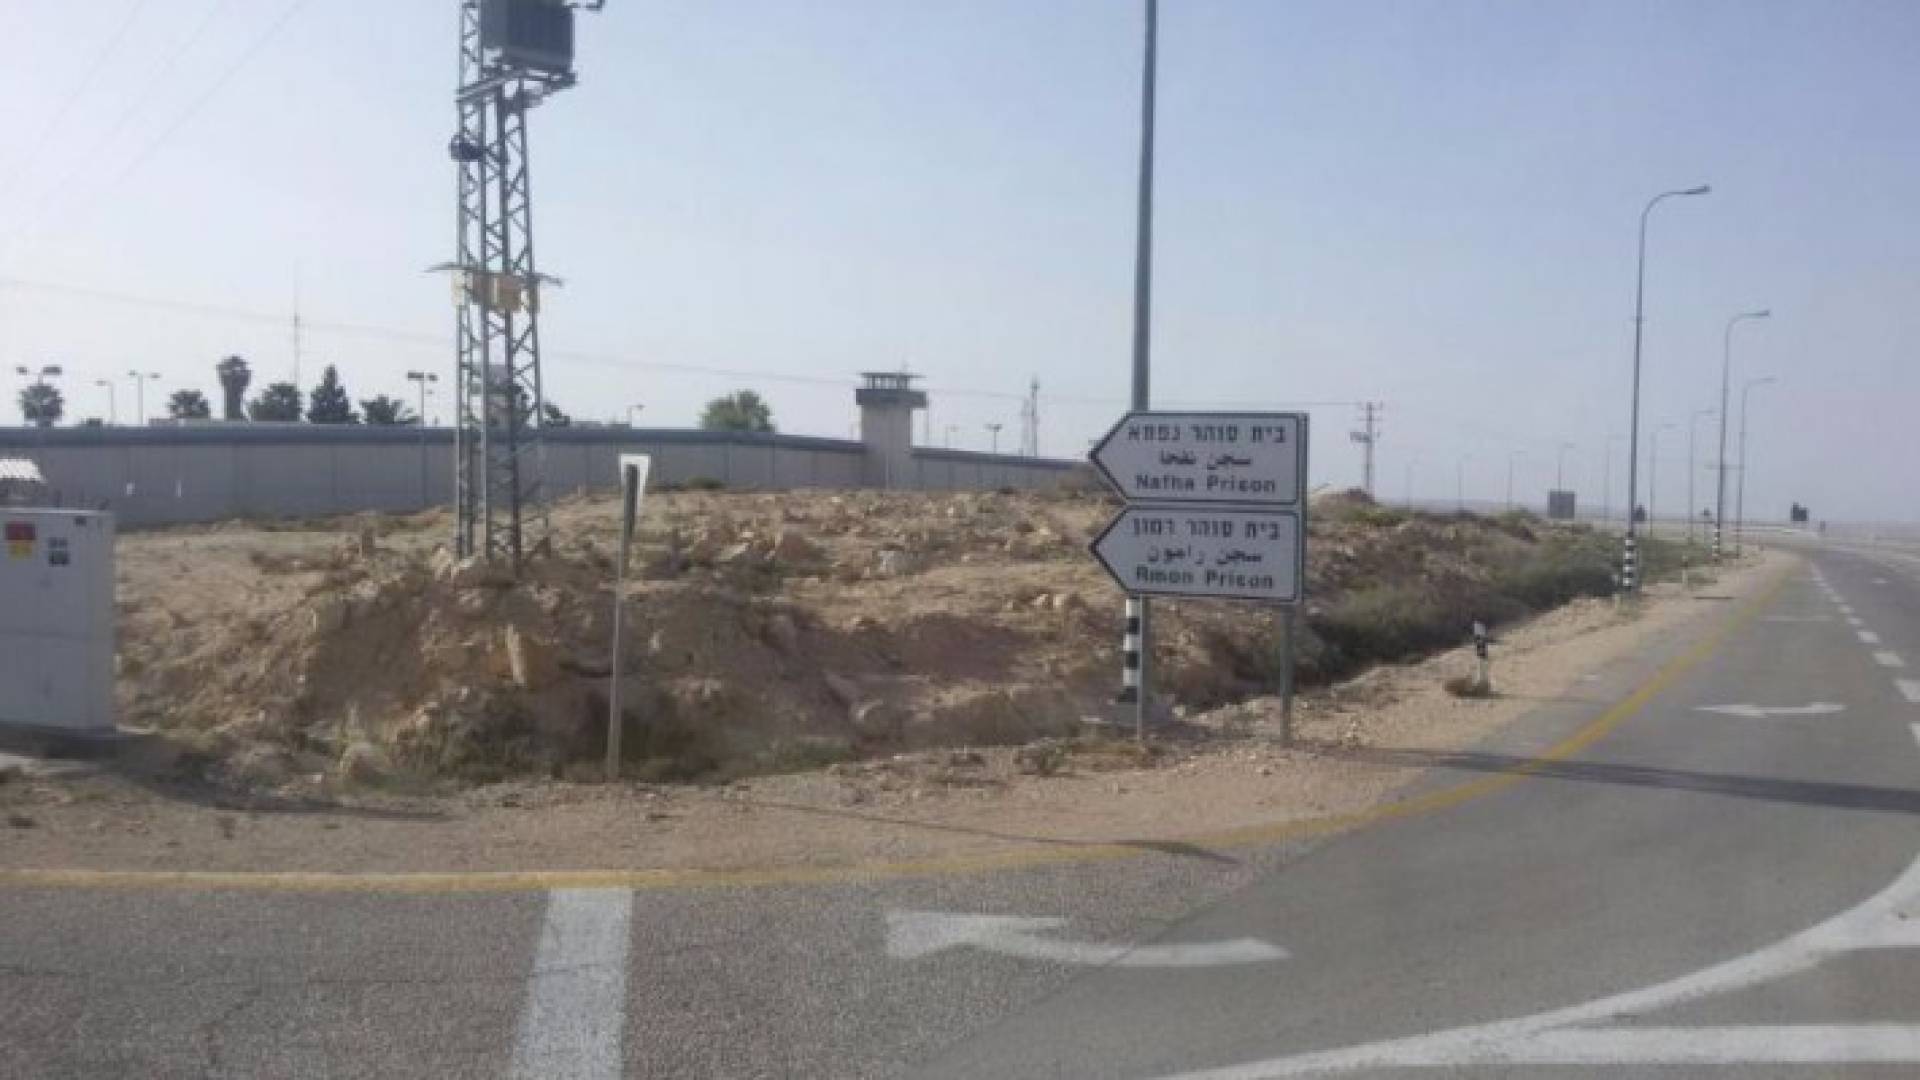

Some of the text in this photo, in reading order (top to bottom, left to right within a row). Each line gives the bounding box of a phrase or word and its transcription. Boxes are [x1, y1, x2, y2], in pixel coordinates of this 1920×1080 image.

[1191, 424, 1238, 441] סוהר
[1251, 425, 1286, 443] בית
[1136, 474, 1275, 492] Nafha Prison
[1185, 519, 1233, 537] סוהר
[1244, 521, 1281, 540] בית
[1206, 569, 1273, 588] Prison
